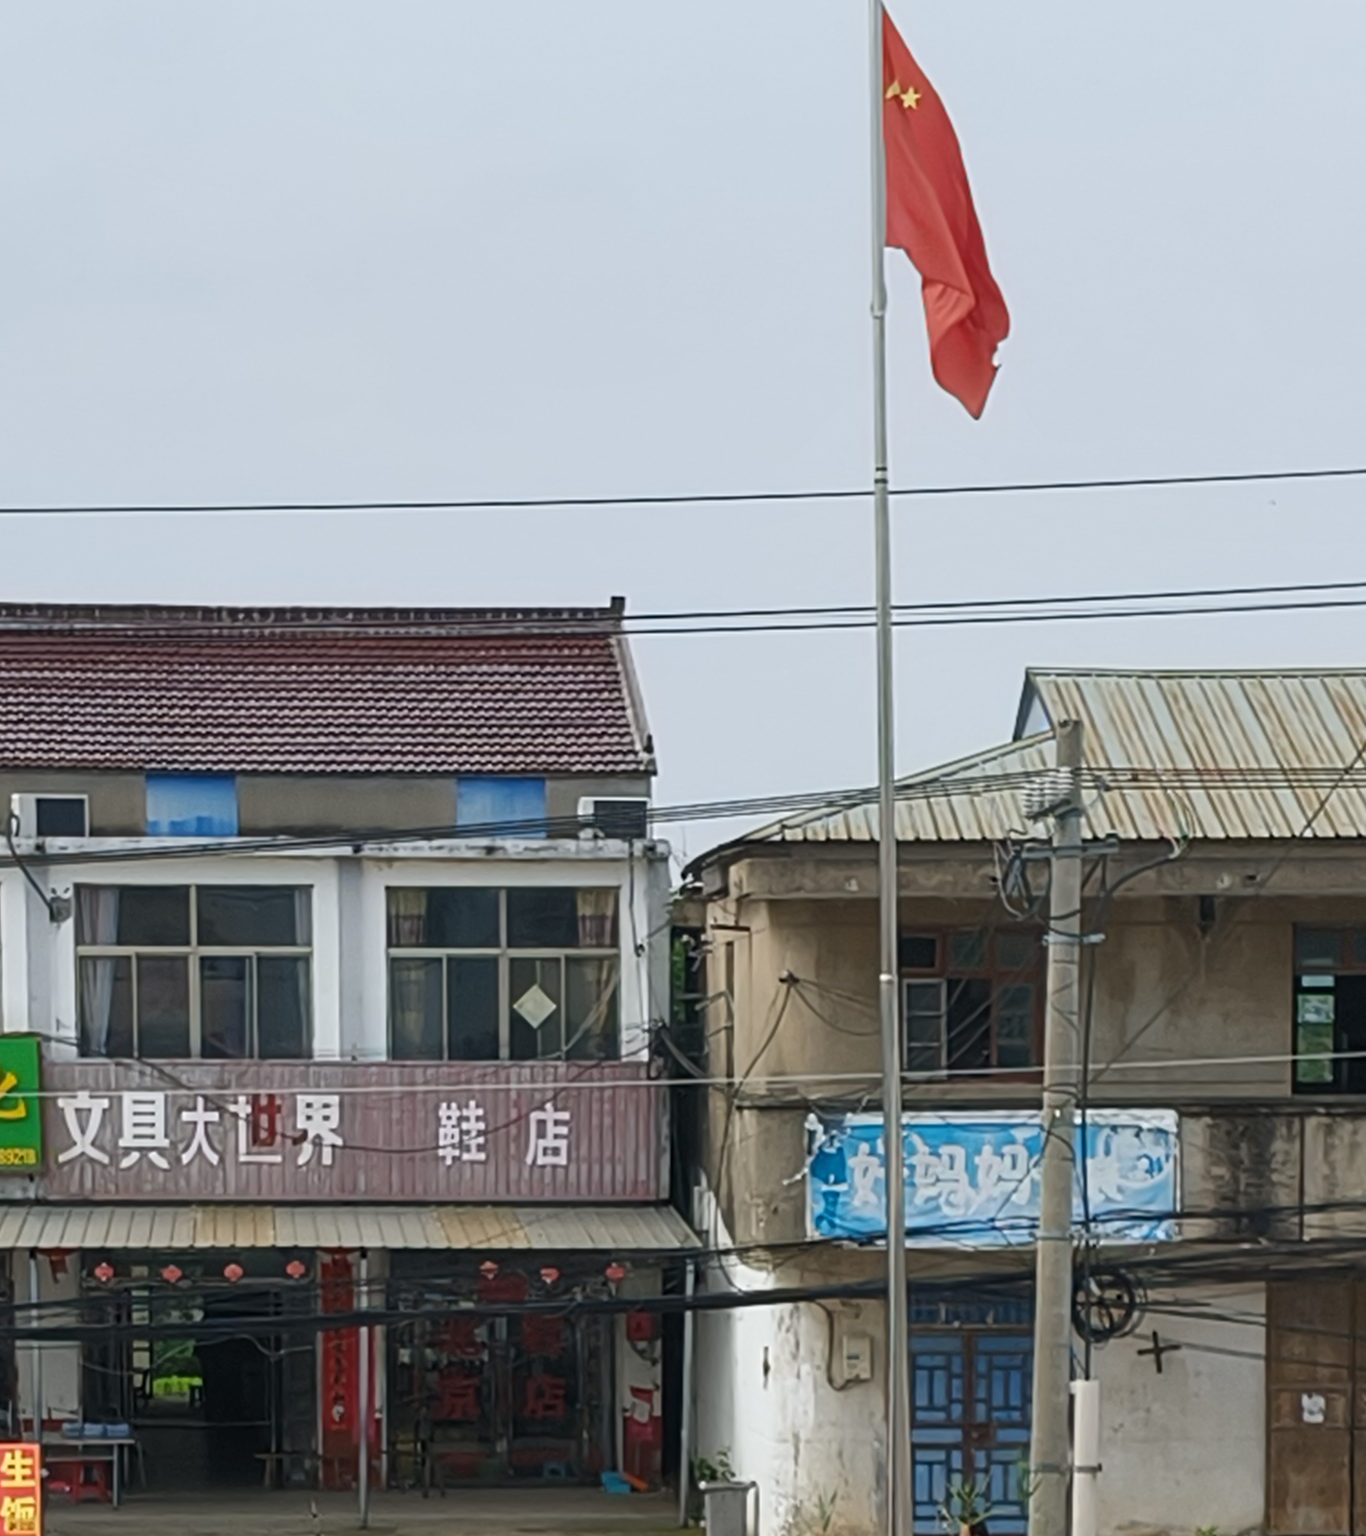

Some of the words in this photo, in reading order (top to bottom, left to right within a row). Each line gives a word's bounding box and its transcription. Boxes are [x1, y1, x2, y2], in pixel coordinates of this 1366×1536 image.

[56, 1091, 343, 1169] 文具大世界
[437, 1100, 570, 1166] 鞋店
